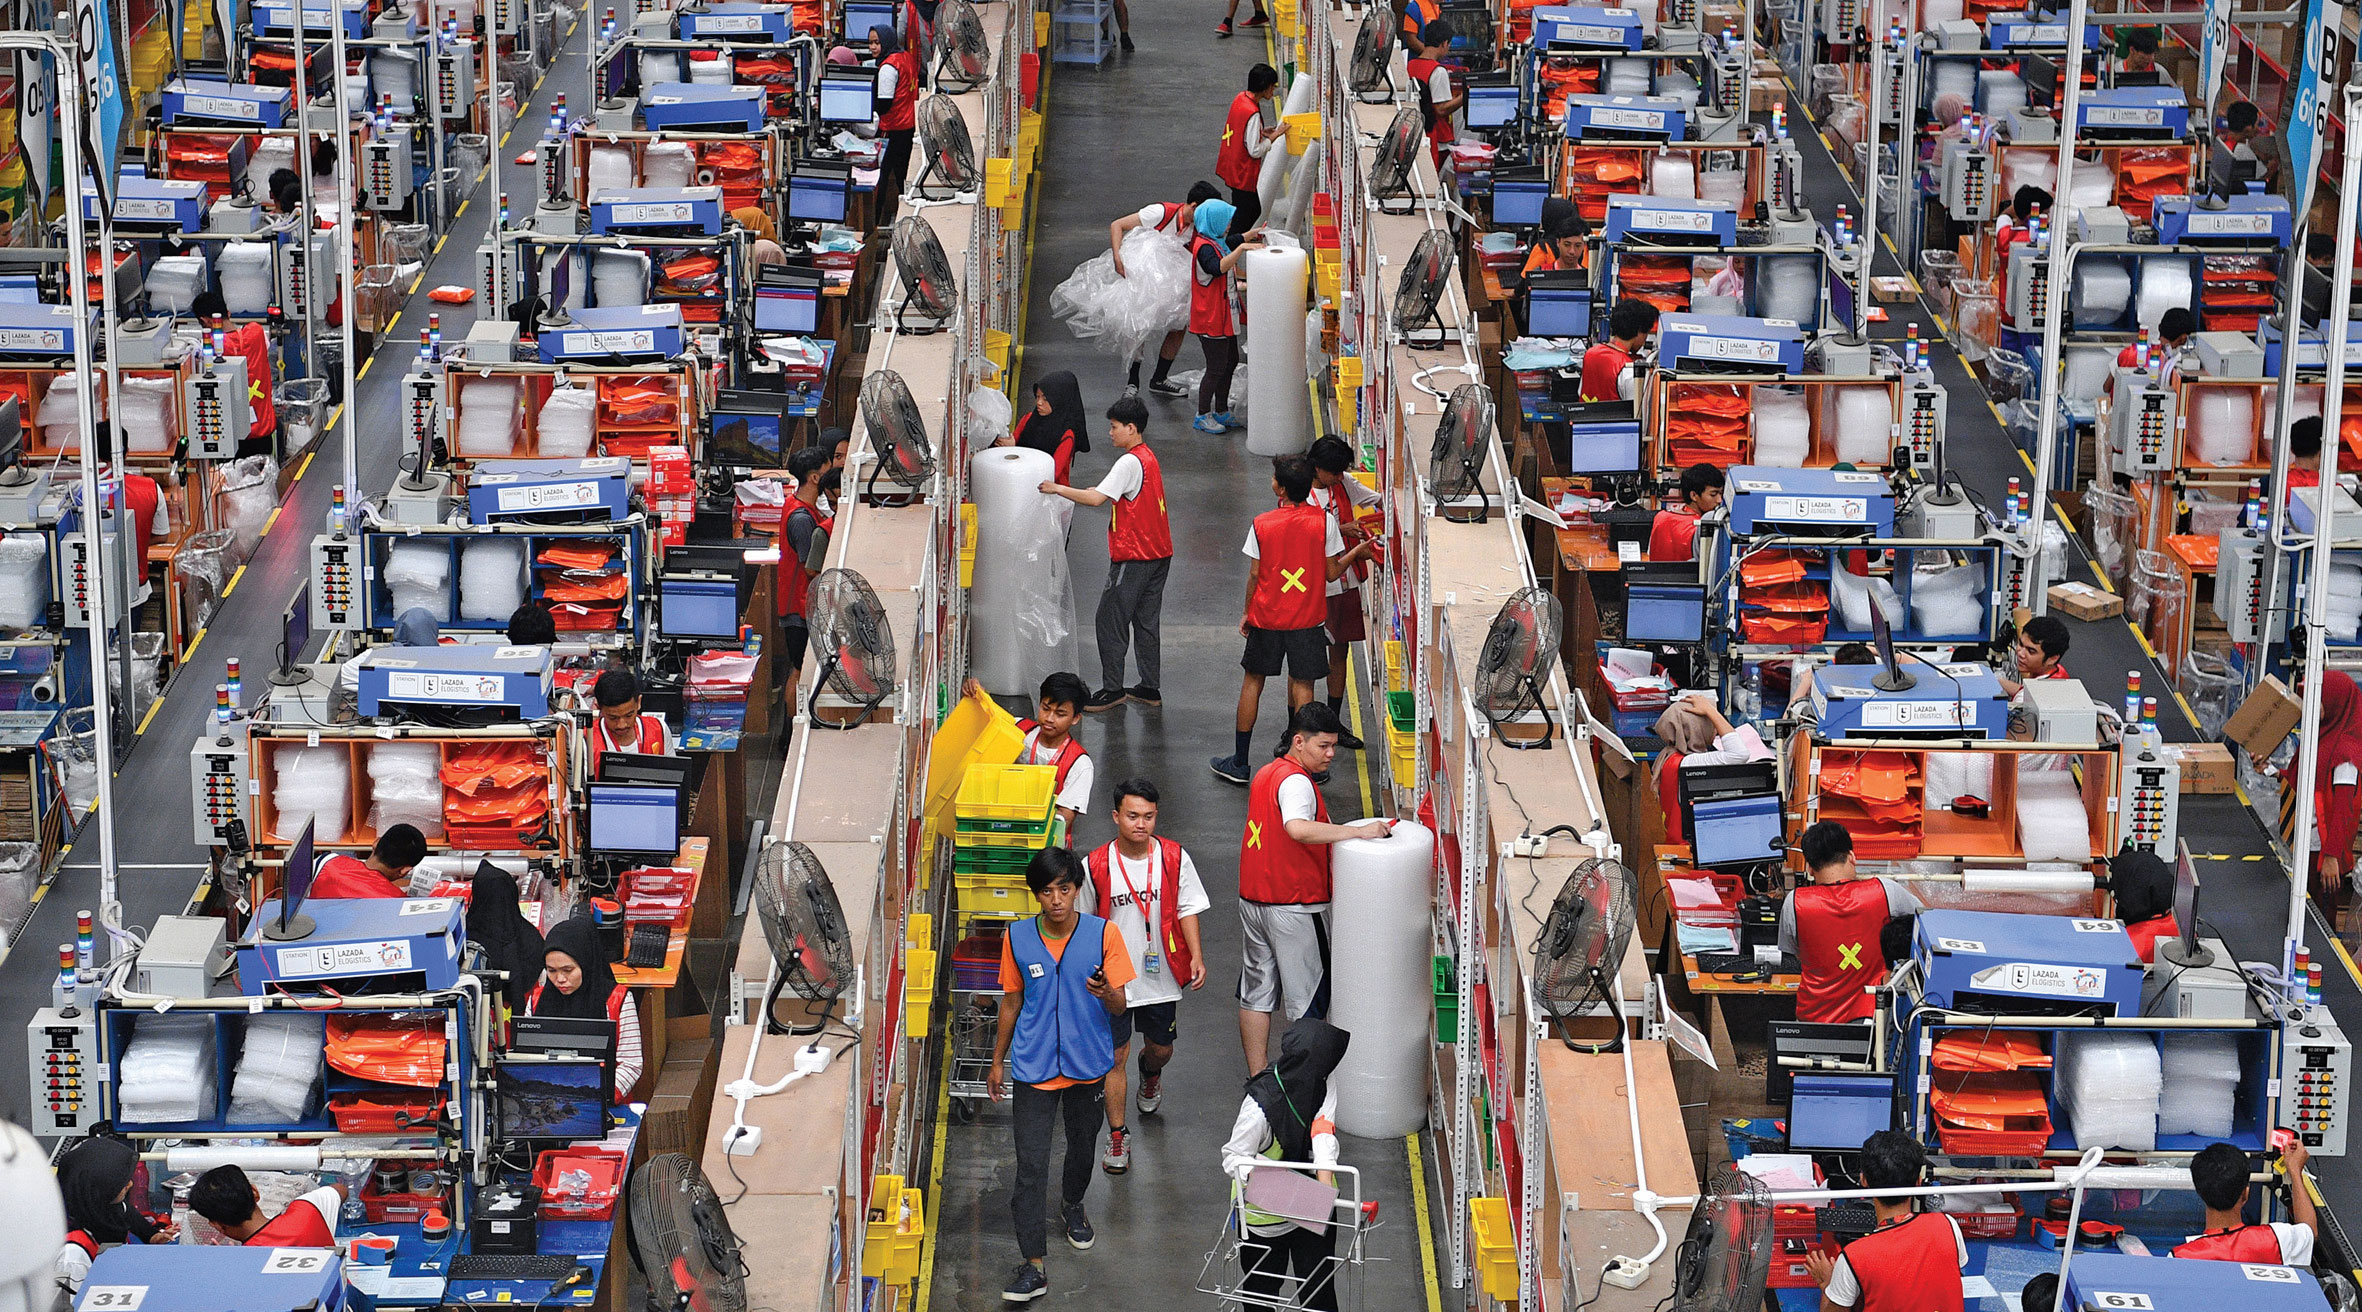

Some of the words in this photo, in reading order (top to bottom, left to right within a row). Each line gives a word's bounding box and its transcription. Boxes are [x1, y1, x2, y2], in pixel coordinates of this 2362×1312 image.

[2215, 15, 2226, 50] 67
[2321, 25, 2337, 84] B
[543, 488, 564, 496] LAZADA
[409, 902, 443, 912] 34
[2079, 922, 2113, 931] 64
[1945, 940, 1979, 949] 63
[337, 949, 364, 957] LAZADA
[338, 956, 371, 965] ELOGISTICS
[2032, 970, 2059, 978] LAZADA
[2032, 979, 2066, 987] ELOGISTICS
[276, 1257, 318, 1268] 32
[2250, 1267, 2291, 1279] 62
[93, 1293, 133, 1306] 31
[2106, 1296, 2146, 1308] 61
